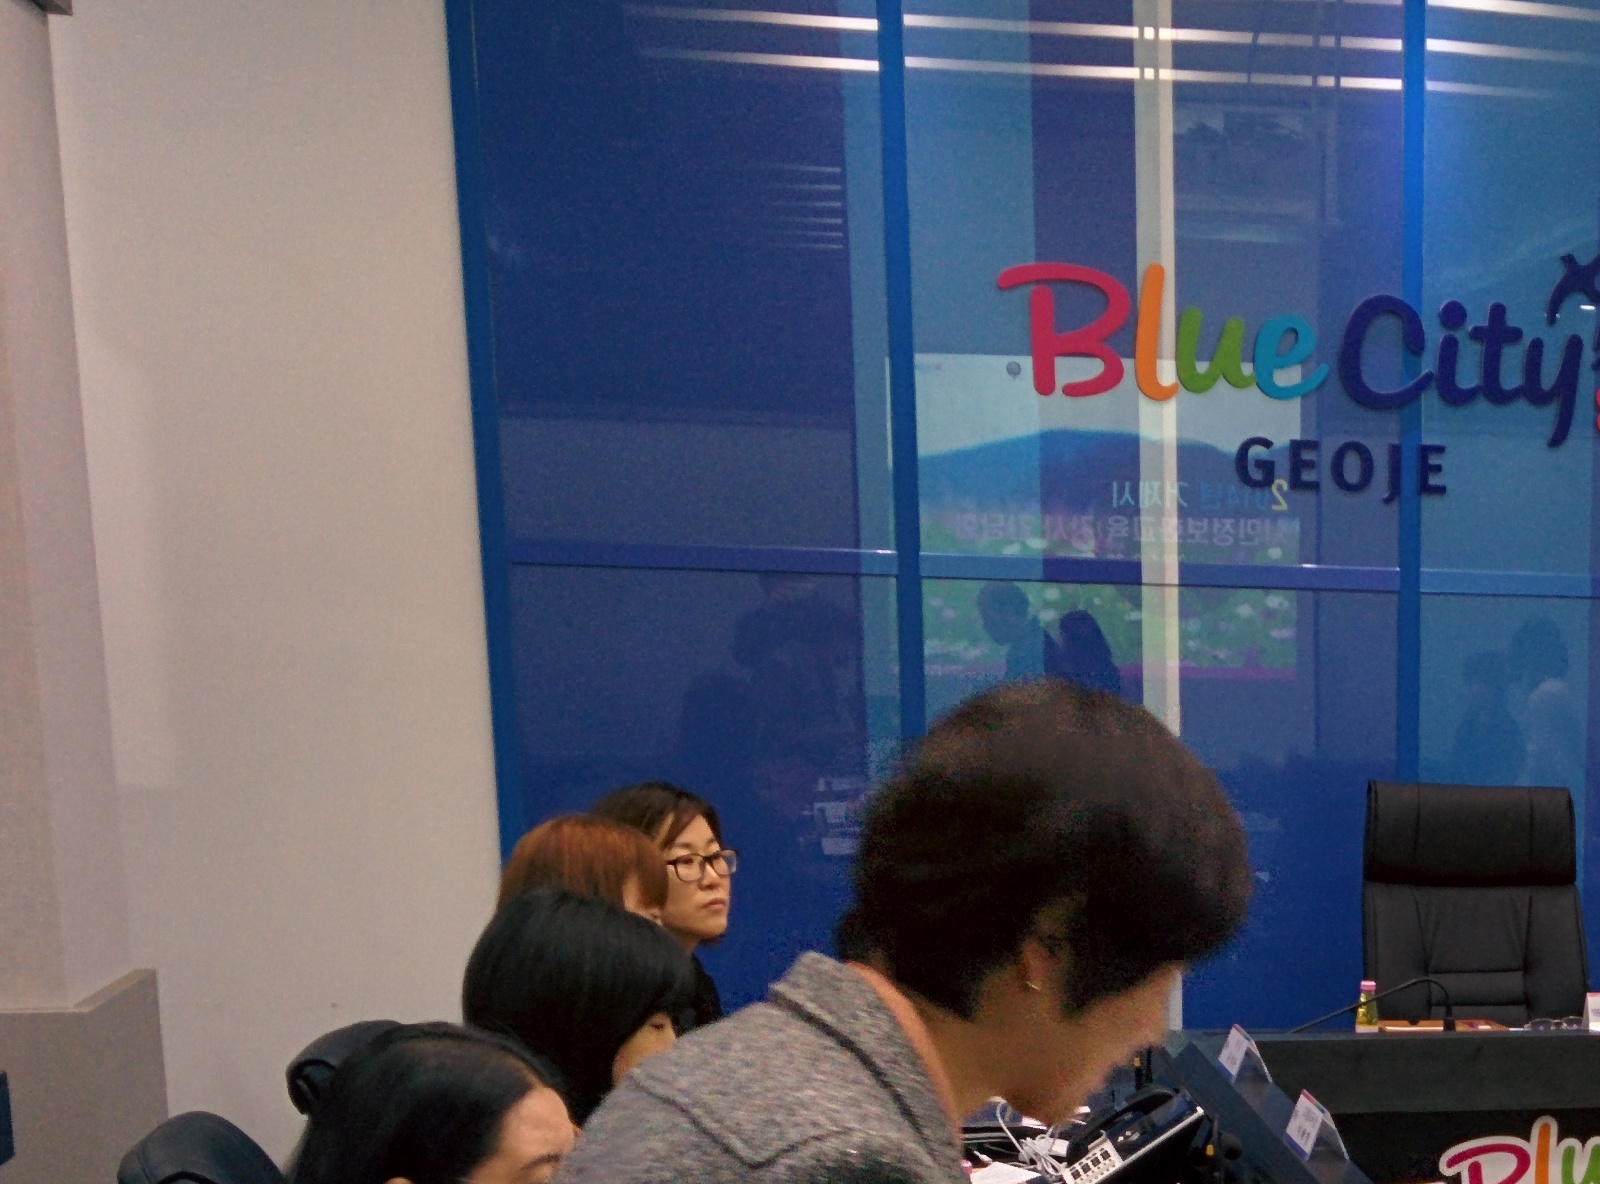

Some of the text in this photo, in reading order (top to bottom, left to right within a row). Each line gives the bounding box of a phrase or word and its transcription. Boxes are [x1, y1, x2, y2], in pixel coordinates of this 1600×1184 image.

[996, 262, 1584, 449] Blue City
[1234, 435, 1447, 504] GEOJE
